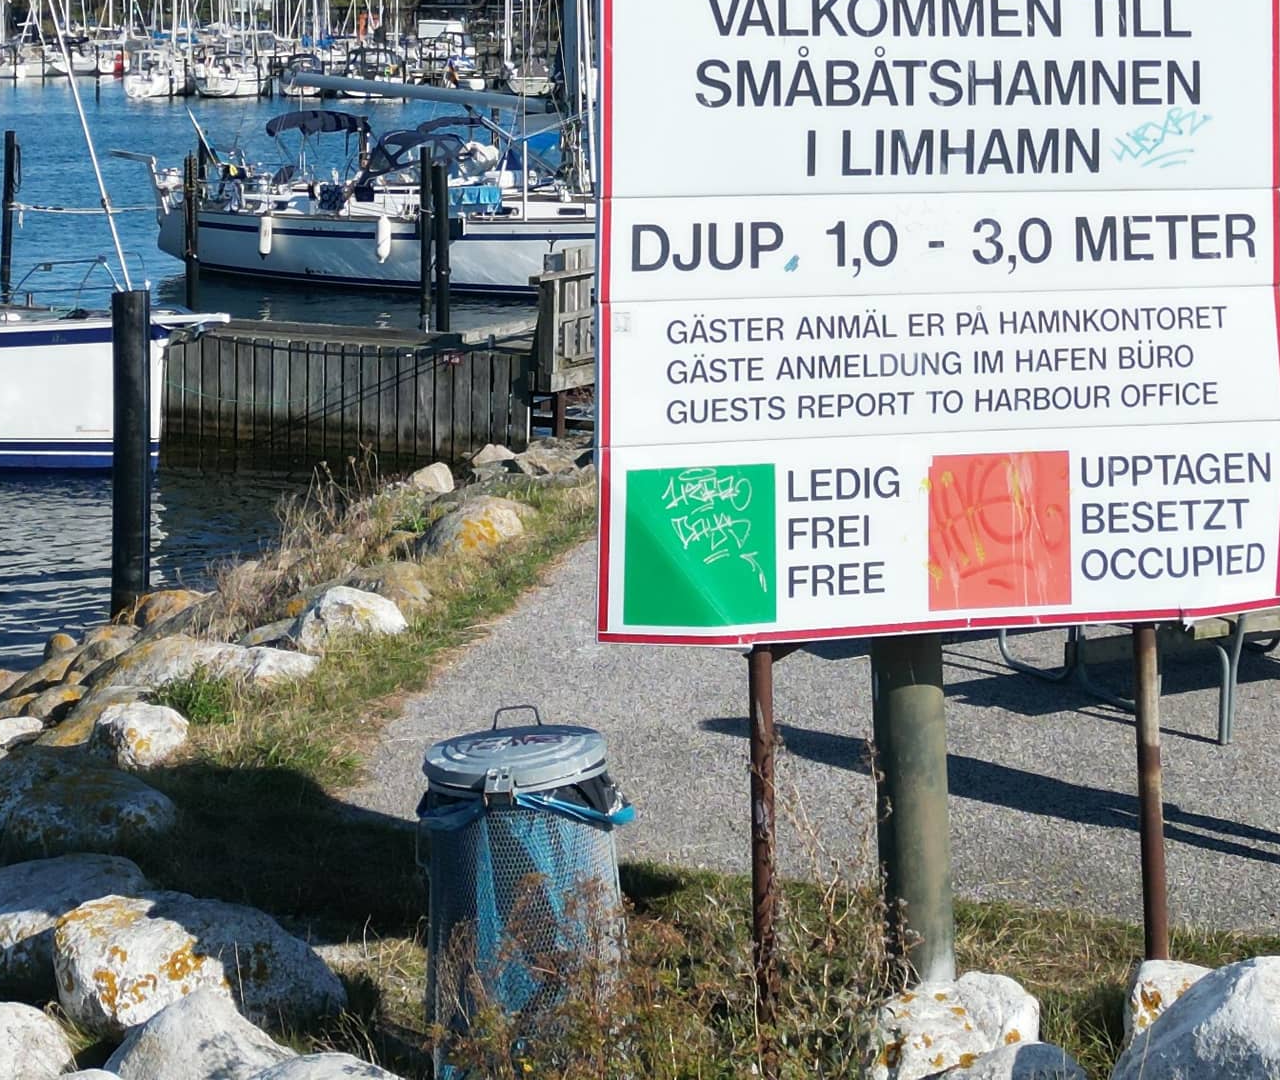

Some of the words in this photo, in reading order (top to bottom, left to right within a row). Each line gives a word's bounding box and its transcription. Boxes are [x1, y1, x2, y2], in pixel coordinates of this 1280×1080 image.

[695, 46, 1201, 108] SMÅBÅTSHAMNEN
[807, 130, 816, 177] I
[841, 128, 1100, 176] LIMHAMN
[826, 219, 898, 277] 1,0
[928, 240, 945, 249] -
[972, 217, 1052, 274] 3,0
[1075, 213, 1256, 263] METER
[666, 313, 784, 345] GÄSTER
[796, 308, 898, 341] ANMÄL
[908, 313, 944, 337] ER
[956, 305, 989, 336] PÅ
[999, 305, 1227, 335] HAMNKONTORET
[666, 353, 764, 385] GÄSTE
[776, 351, 962, 381] ANMELDUNG
[974, 350, 1004, 374] IM
[1015, 347, 1107, 373] HAFEN
[1118, 339, 1194, 370] BÜRO
[666, 395, 786, 425] GUESTS
[798, 391, 915, 419] REPORT
[928, 390, 964, 414] TO
[975, 385, 1110, 413] HARBOUR
[1121, 381, 1218, 407] OFFICE
[788, 466, 900, 502] LEDIG
[1081, 452, 1271, 488] UPPTAGEN
[788, 514, 870, 550] FREI
[1081, 498, 1250, 534] BESETZT
[788, 561, 885, 598] FREE
[1081, 542, 1265, 581] OCCUPIED
